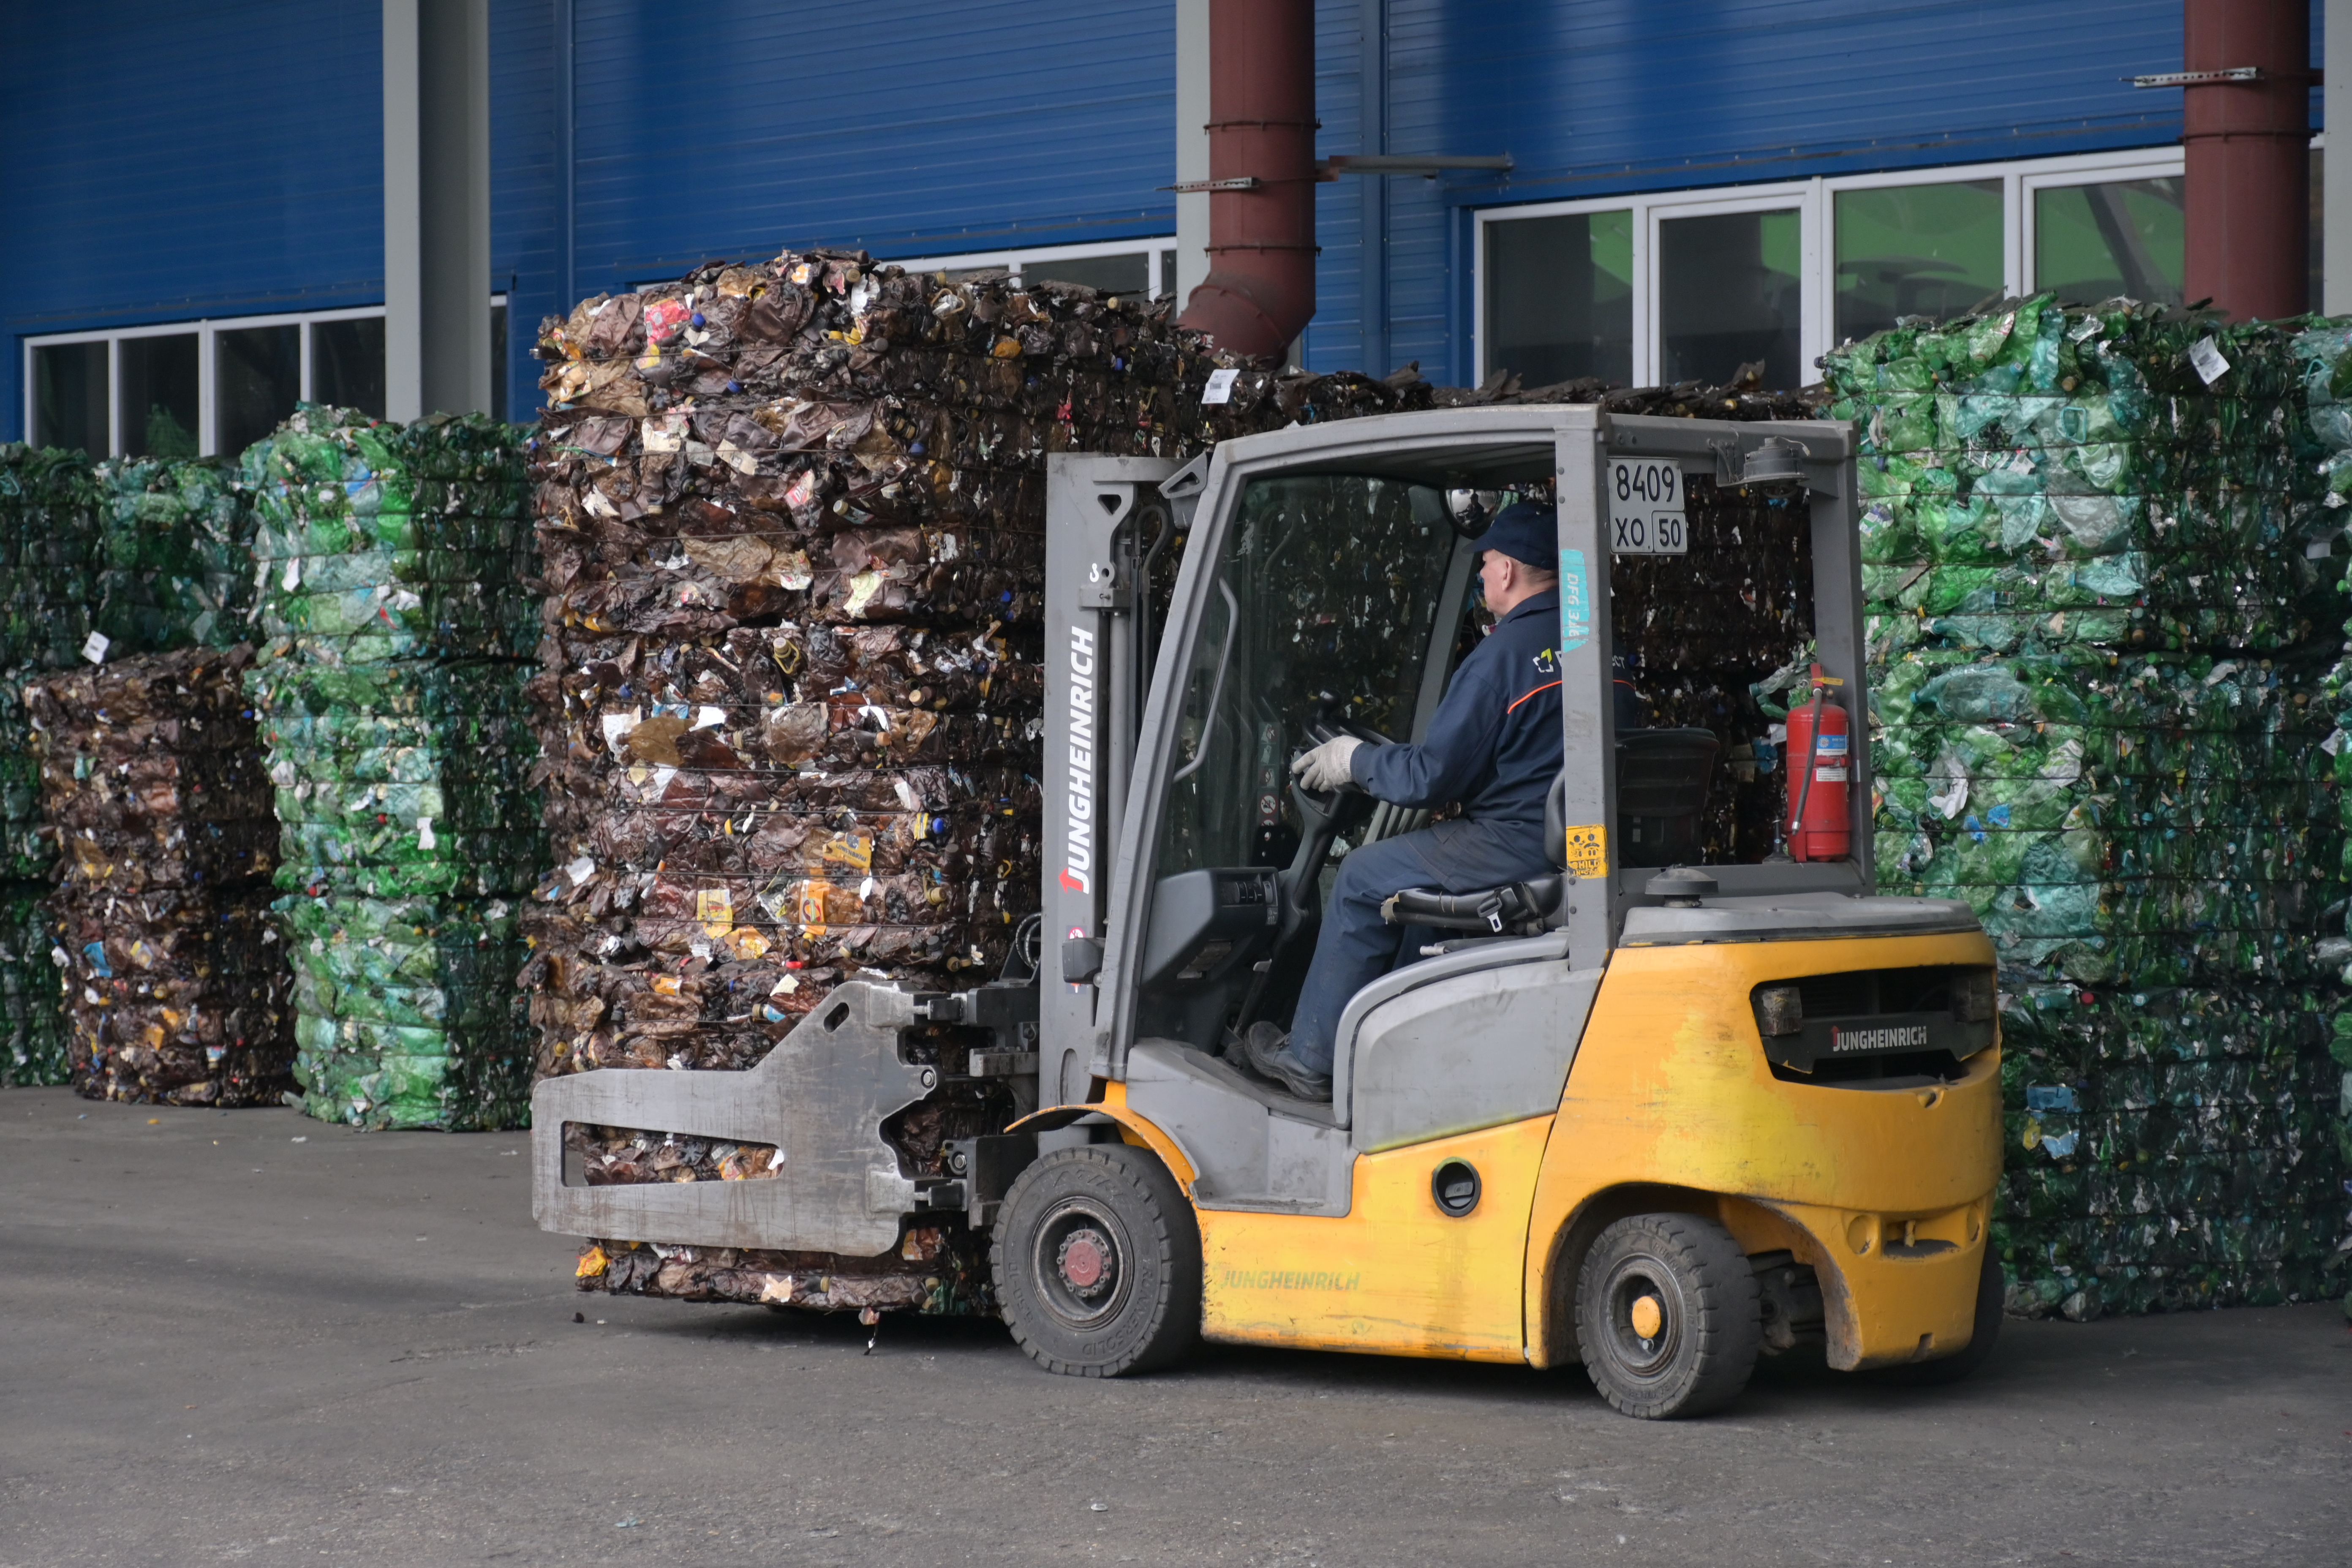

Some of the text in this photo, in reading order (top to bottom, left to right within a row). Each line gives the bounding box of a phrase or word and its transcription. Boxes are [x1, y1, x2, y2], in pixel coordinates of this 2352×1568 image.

[1615, 465, 1674, 502] 8409
[1658, 518, 1681, 547] 50
[1568, 573, 1579, 606] DFG
[1067, 626, 1093, 894] JUNGHEINRICH
[1833, 1026, 1927, 1051] JUNGHEINRICH
[1218, 1270, 1361, 1291] JUNGHEINRICH
